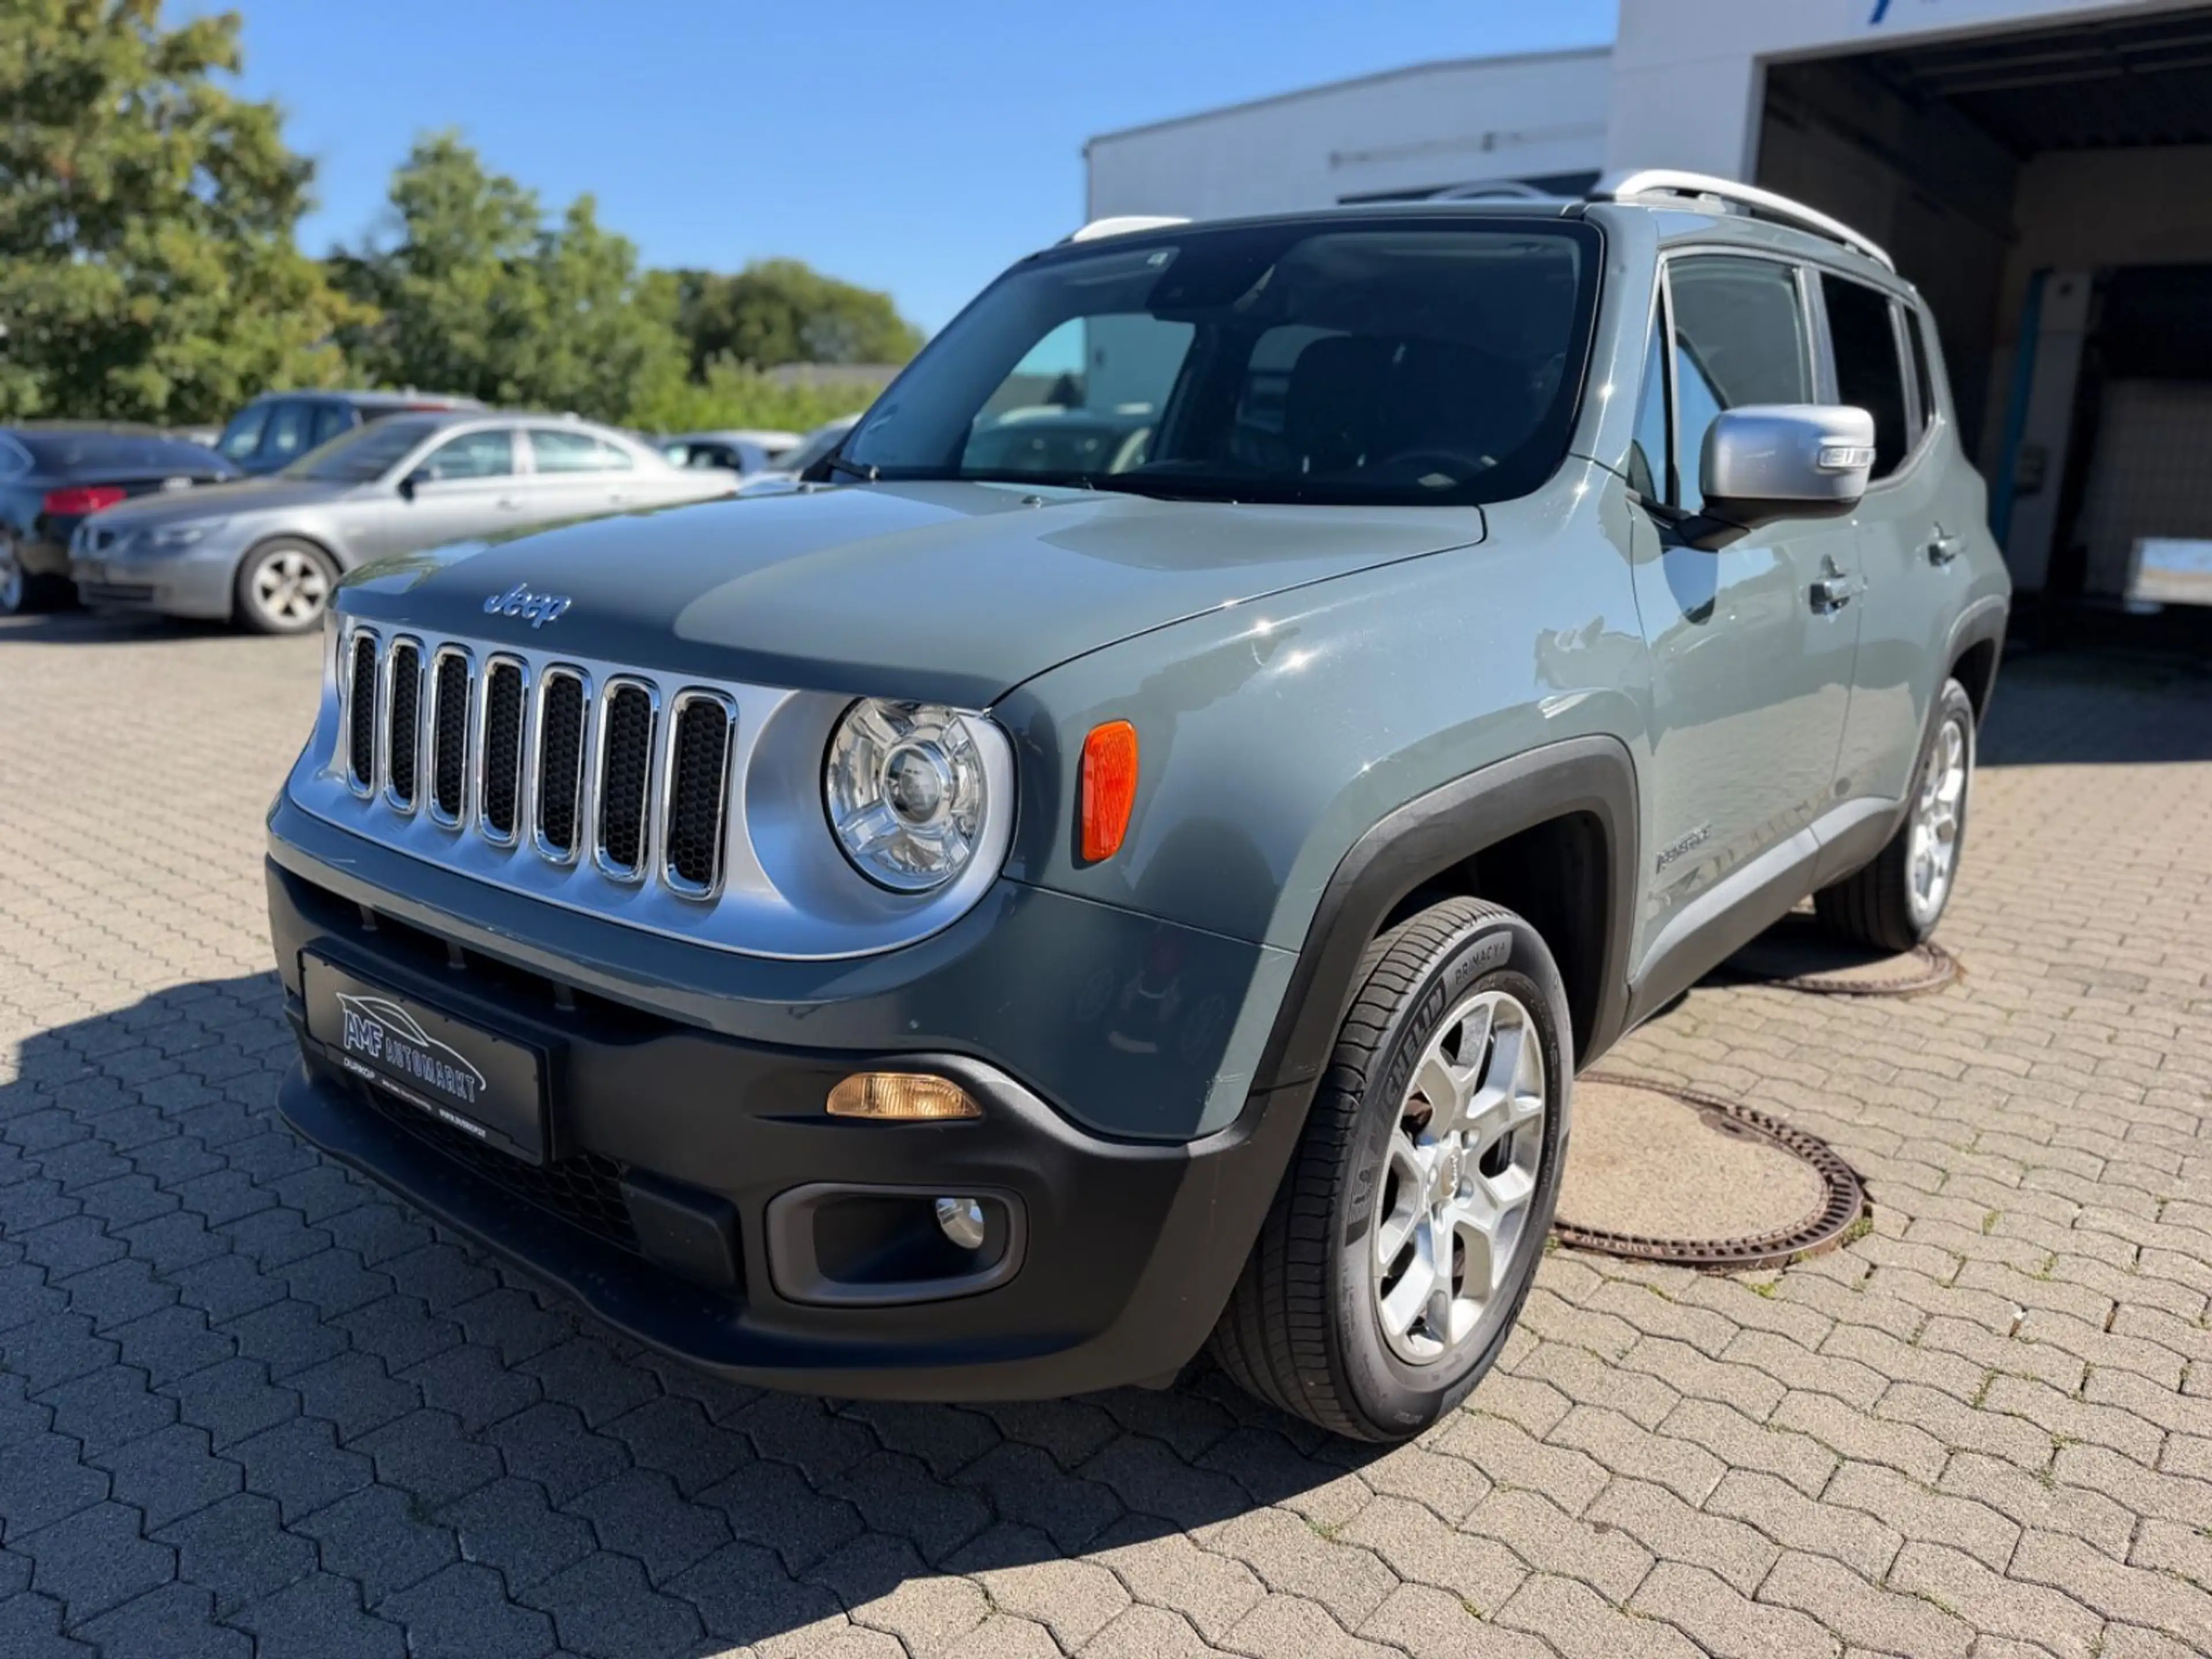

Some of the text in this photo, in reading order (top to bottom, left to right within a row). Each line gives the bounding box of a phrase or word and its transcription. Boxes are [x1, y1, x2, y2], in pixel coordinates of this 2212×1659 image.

[484, 582, 571, 630] Jeep
[1455, 943, 1499, 985] PRMACY
[344, 1009, 384, 1058] AMF
